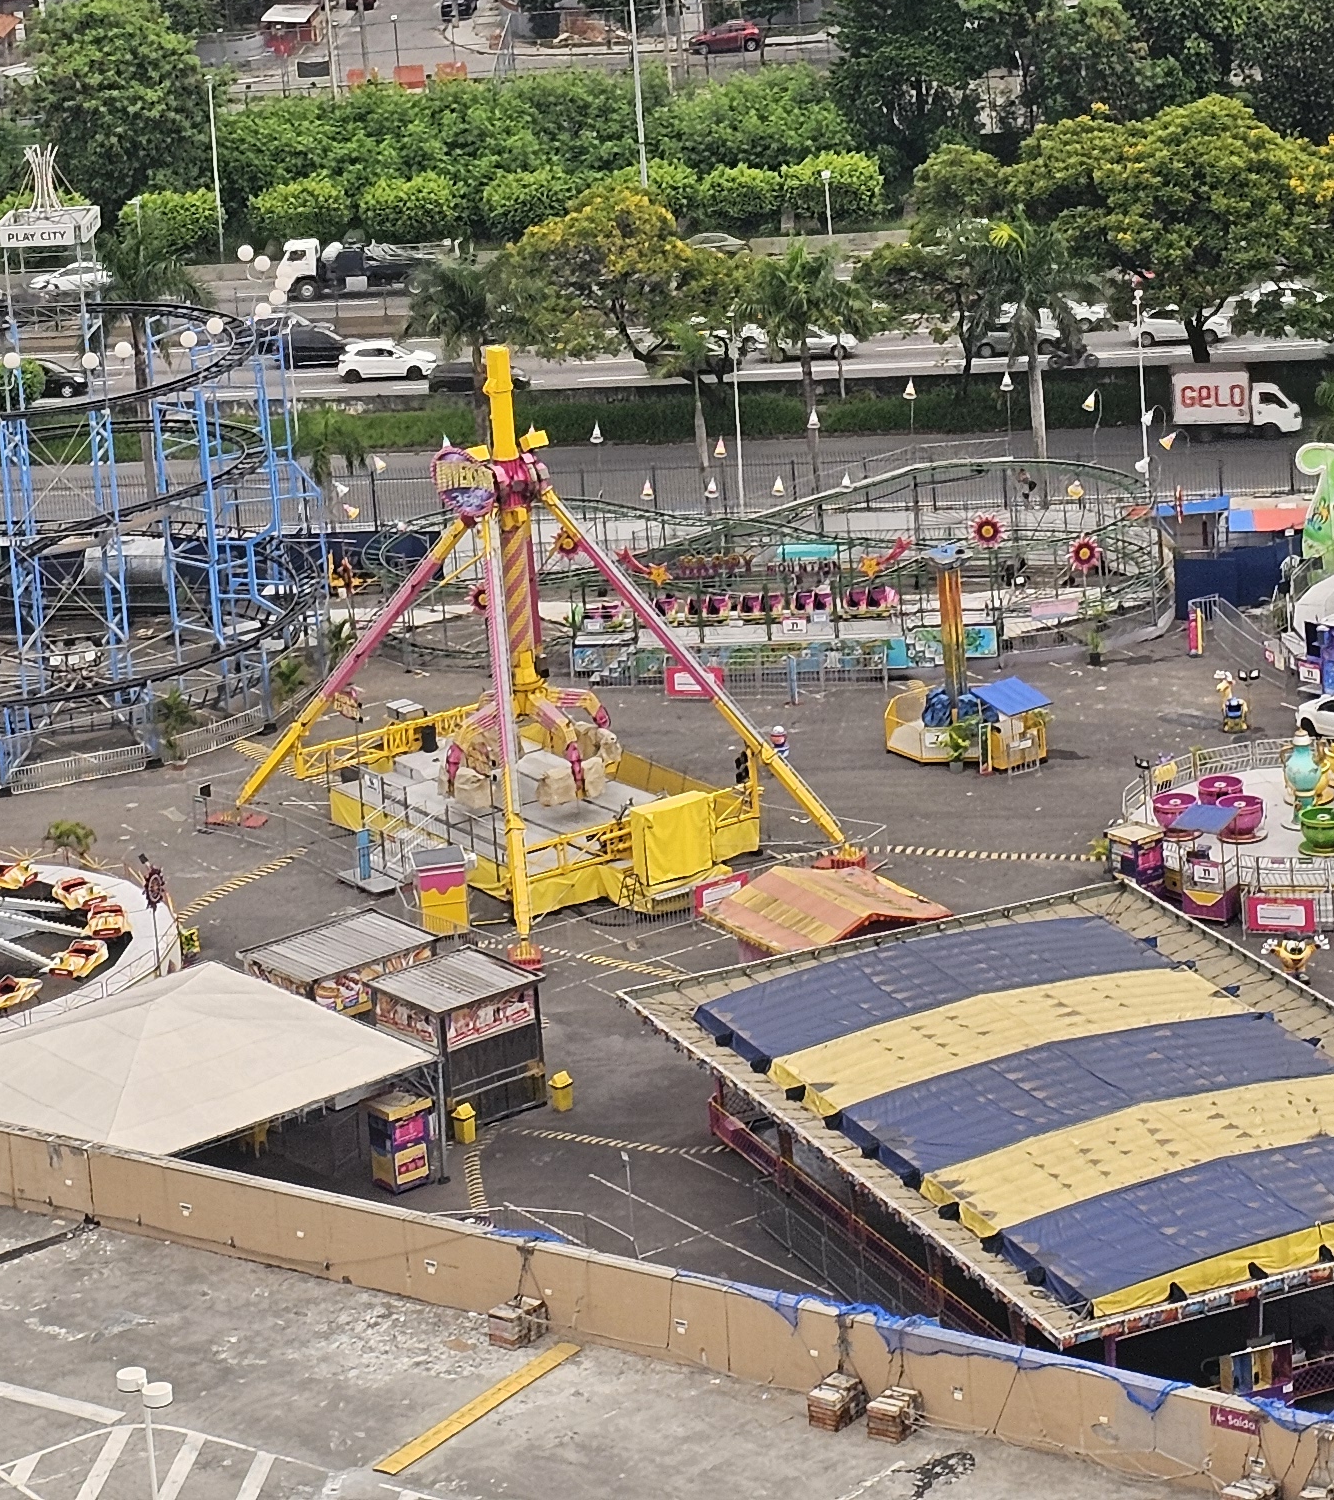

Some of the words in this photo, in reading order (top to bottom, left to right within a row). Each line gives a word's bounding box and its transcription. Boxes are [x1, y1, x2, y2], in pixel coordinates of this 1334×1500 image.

[7, 232, 36, 243] PLAY
[40, 230, 67, 241] CITY
[1227, 1414, 1256, 1430] Saída
